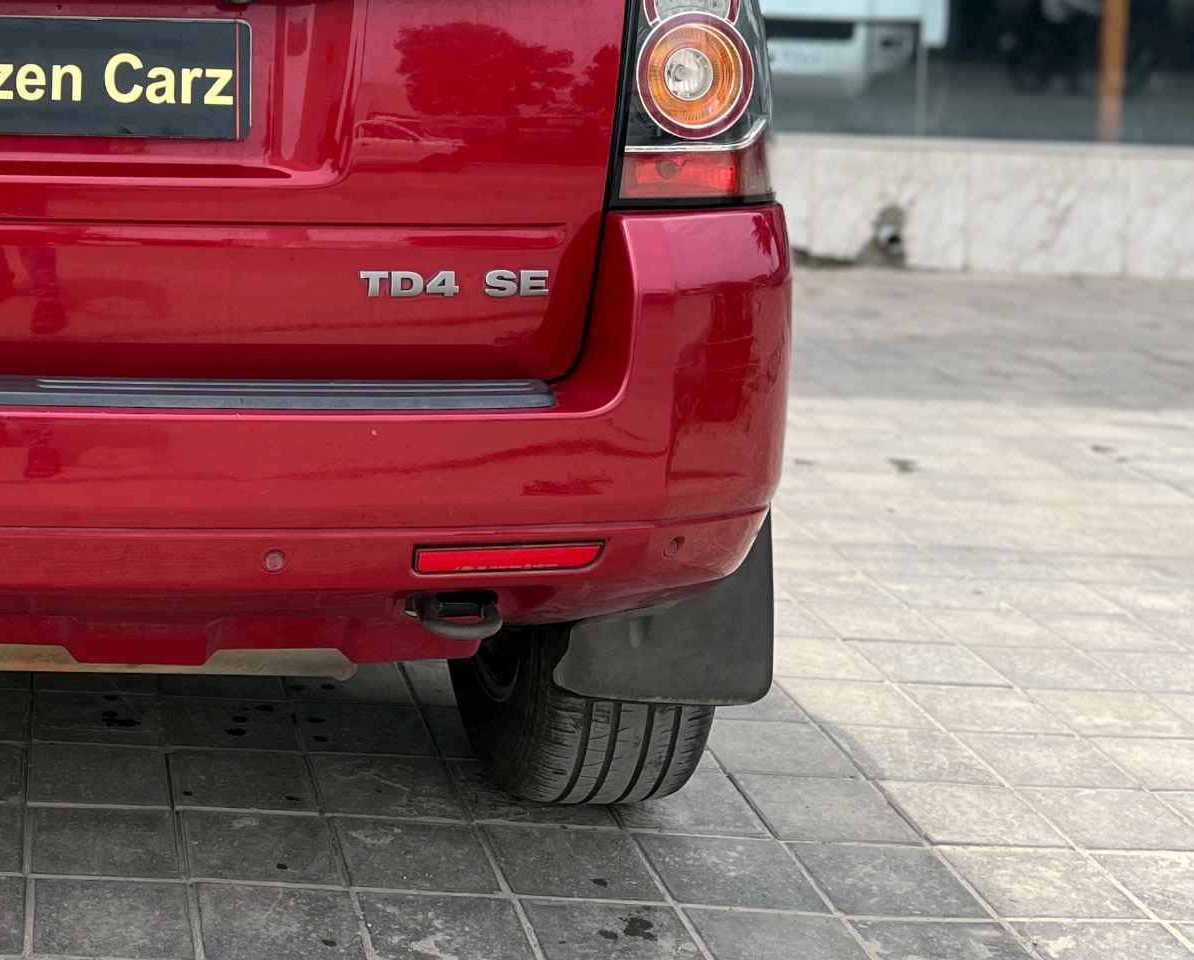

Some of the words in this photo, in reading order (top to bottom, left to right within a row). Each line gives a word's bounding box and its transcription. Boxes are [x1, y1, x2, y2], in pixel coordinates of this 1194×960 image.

[104, 52, 234, 105] Carz
[359, 270, 459, 297] TD4
[484, 269, 550, 297] SE
